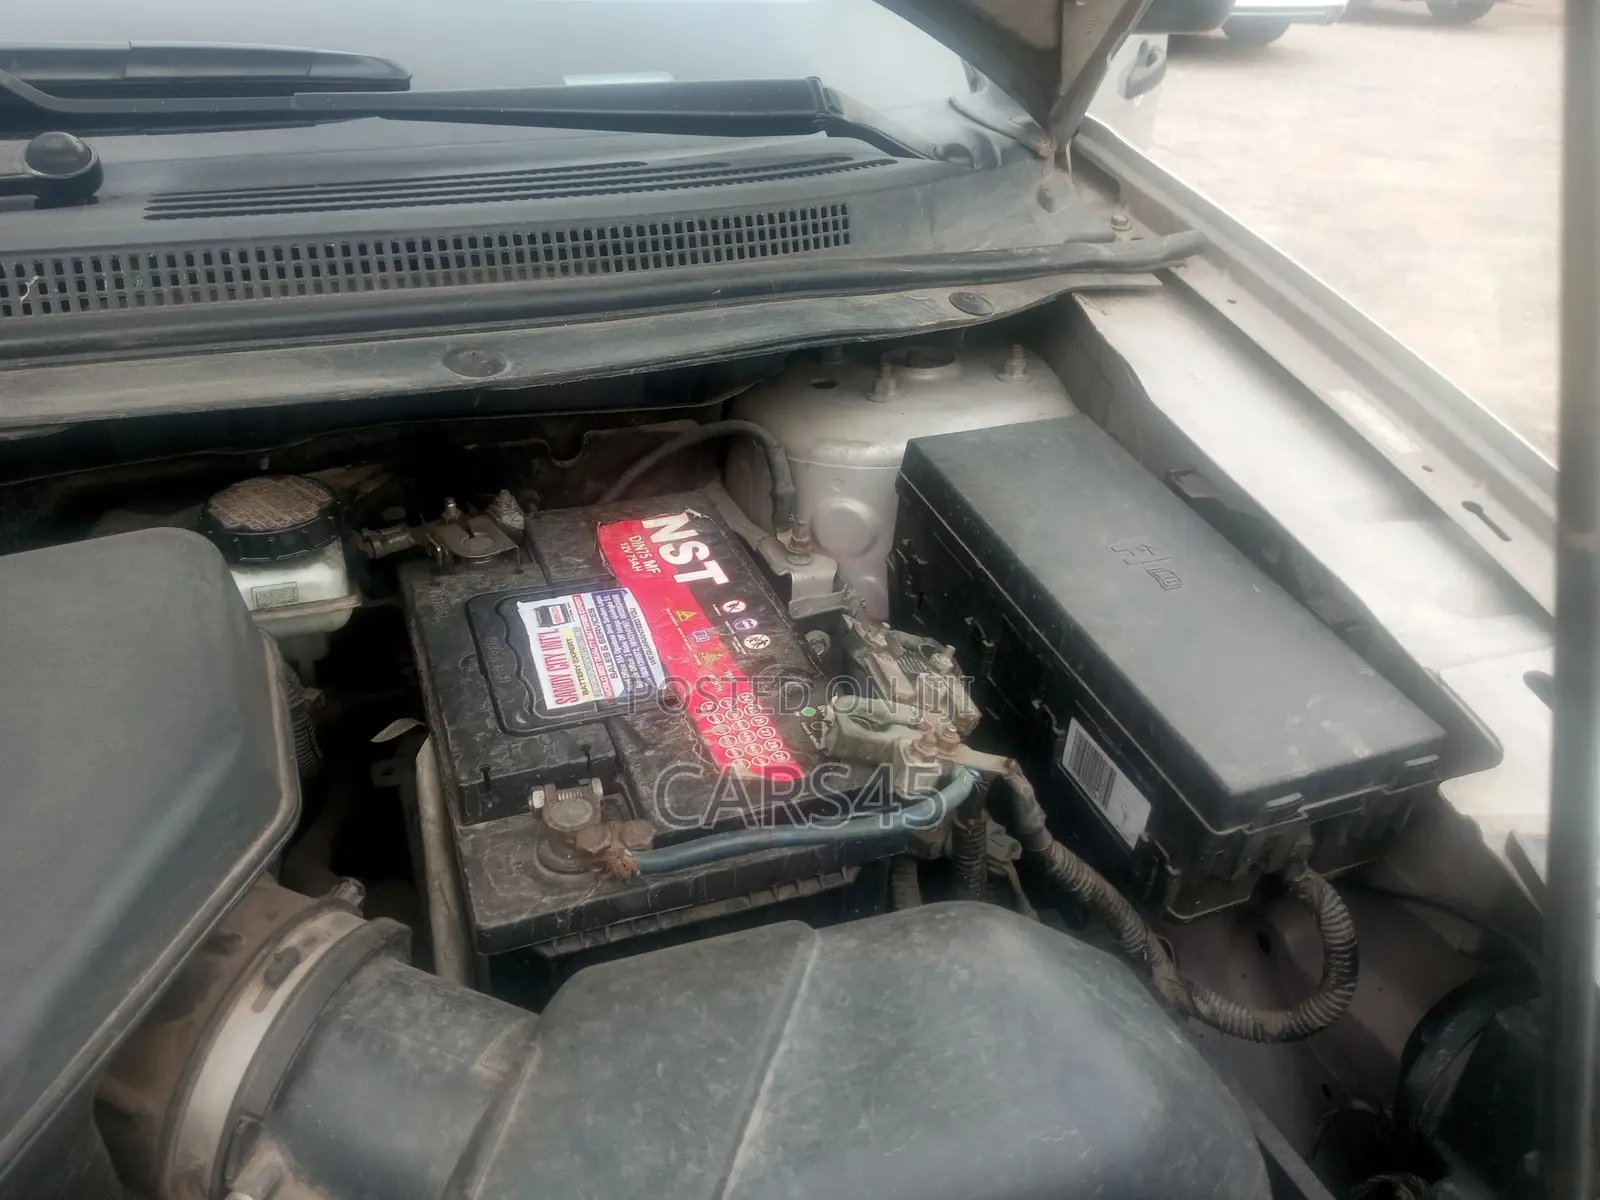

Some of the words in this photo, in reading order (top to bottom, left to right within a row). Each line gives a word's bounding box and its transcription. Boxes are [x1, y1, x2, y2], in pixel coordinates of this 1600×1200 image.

[619, 542, 632, 554] 12V
[628, 535, 653, 559] DIN75
[644, 558, 661, 575] MF
[641, 512, 730, 585] NST
[586, 606, 607, 644] SERVICES
[543, 652, 570, 673] CITY
[565, 637, 579, 665] EXPERT
[601, 651, 619, 679] SALES
[549, 672, 579, 705] SANDY
[573, 662, 589, 696] BATTERY
